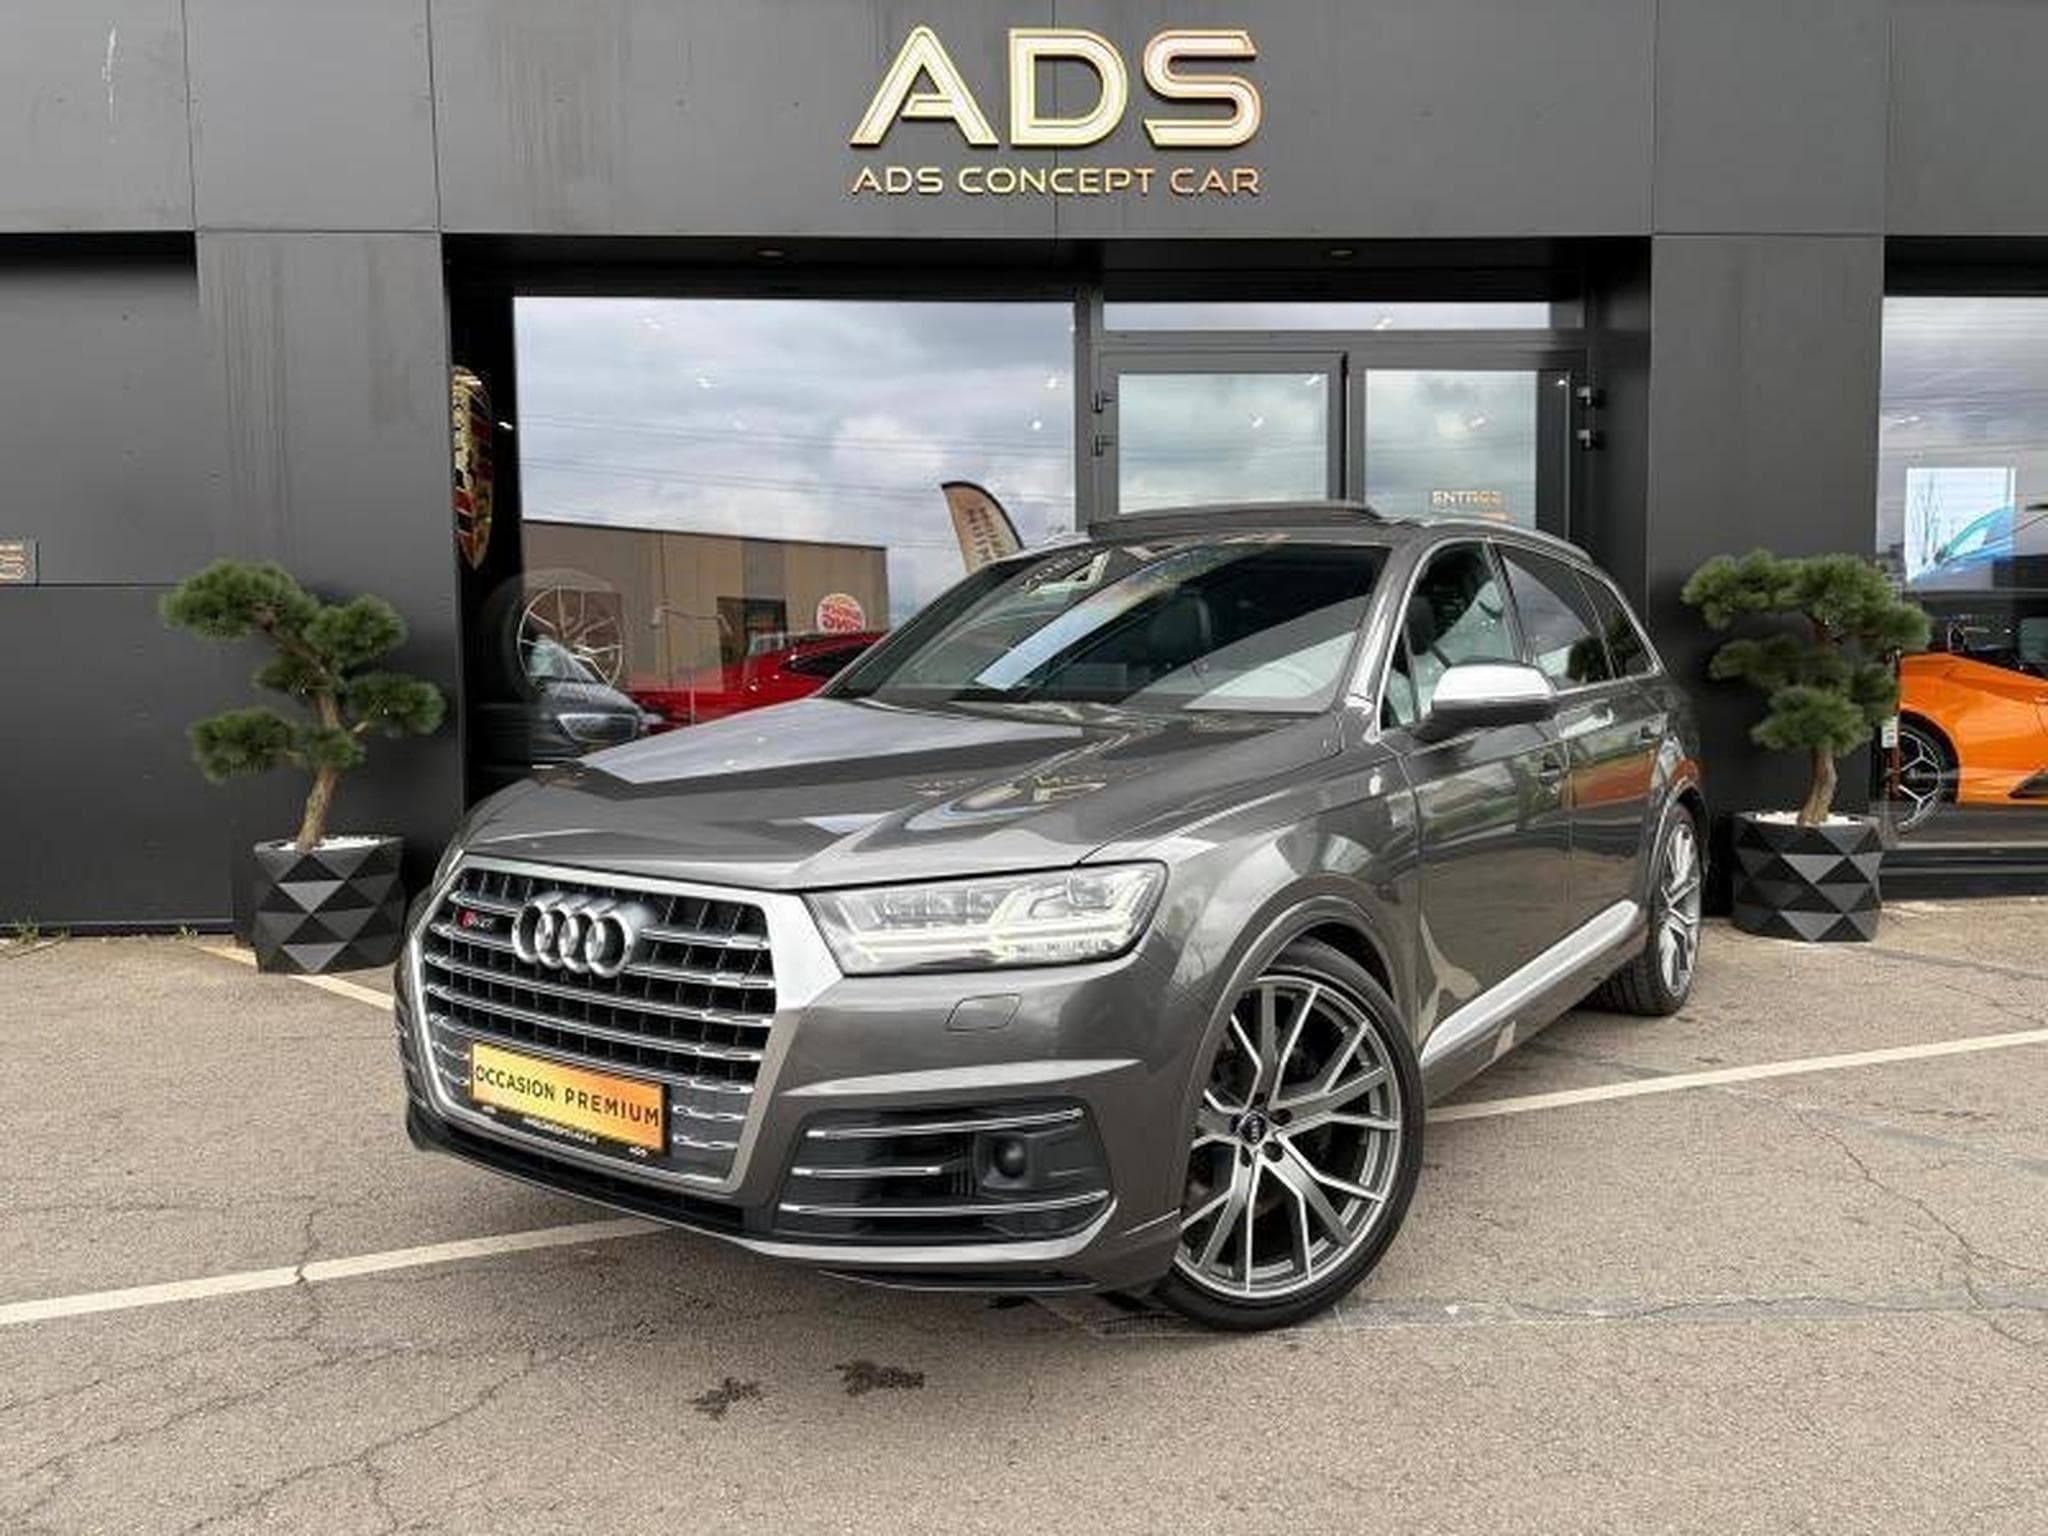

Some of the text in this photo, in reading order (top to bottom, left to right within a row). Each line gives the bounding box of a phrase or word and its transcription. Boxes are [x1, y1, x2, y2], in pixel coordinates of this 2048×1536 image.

[850, 25, 1263, 148] ADS
[851, 166, 1261, 195] ADS CONCEPT CAR
[475, 1064, 660, 1127] OCCASION PREMIUM
